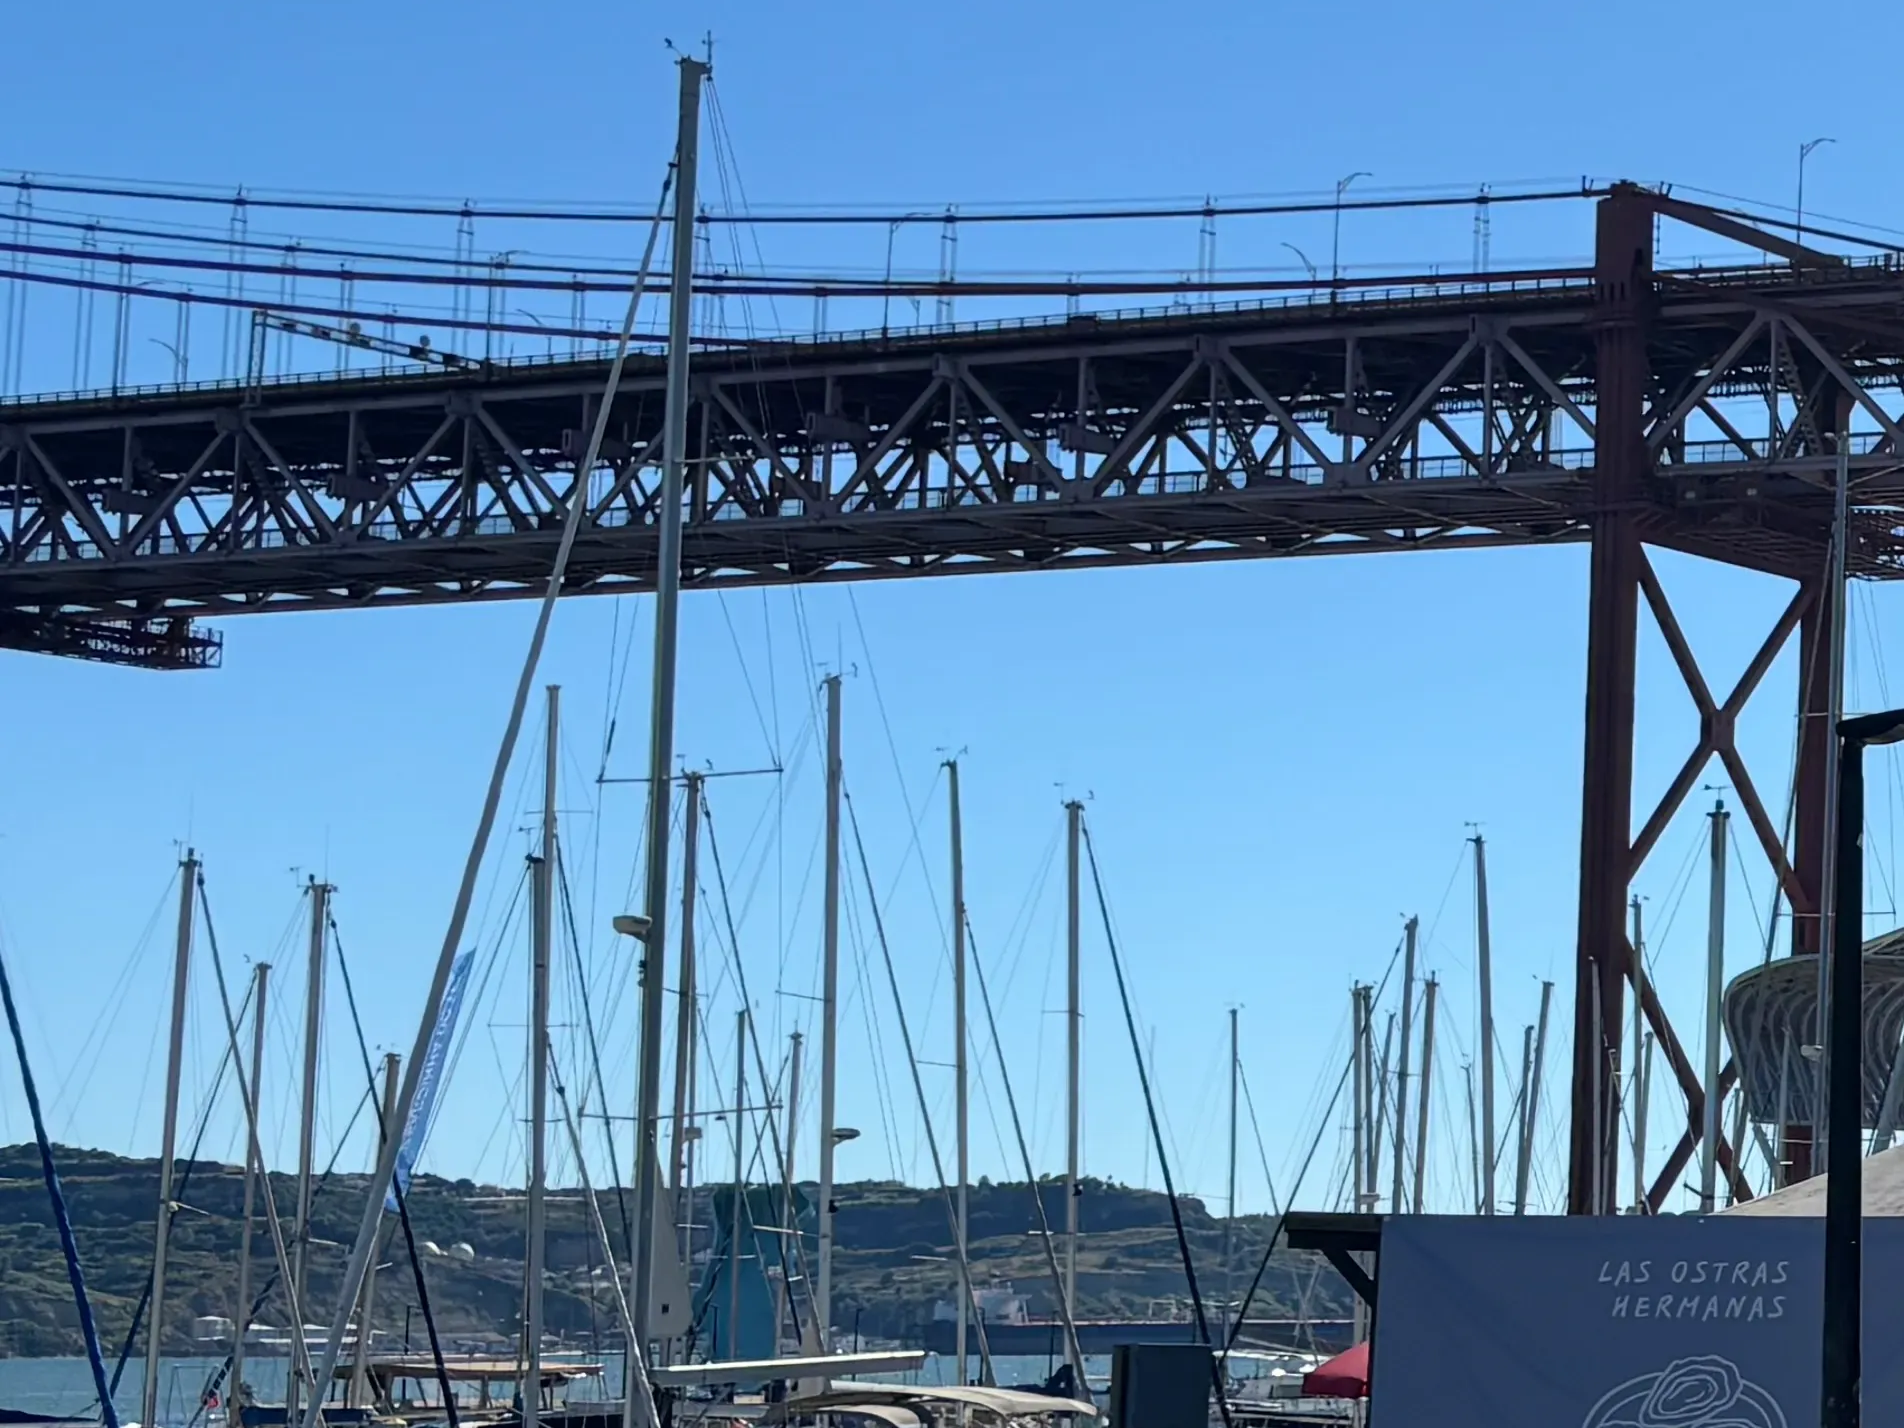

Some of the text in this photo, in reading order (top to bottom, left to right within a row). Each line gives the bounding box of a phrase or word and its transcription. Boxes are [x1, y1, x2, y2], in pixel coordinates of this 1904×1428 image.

[1598, 1260, 1790, 1287] LAS OSTRAS
[1612, 1294, 1787, 1322] HERMANAS
